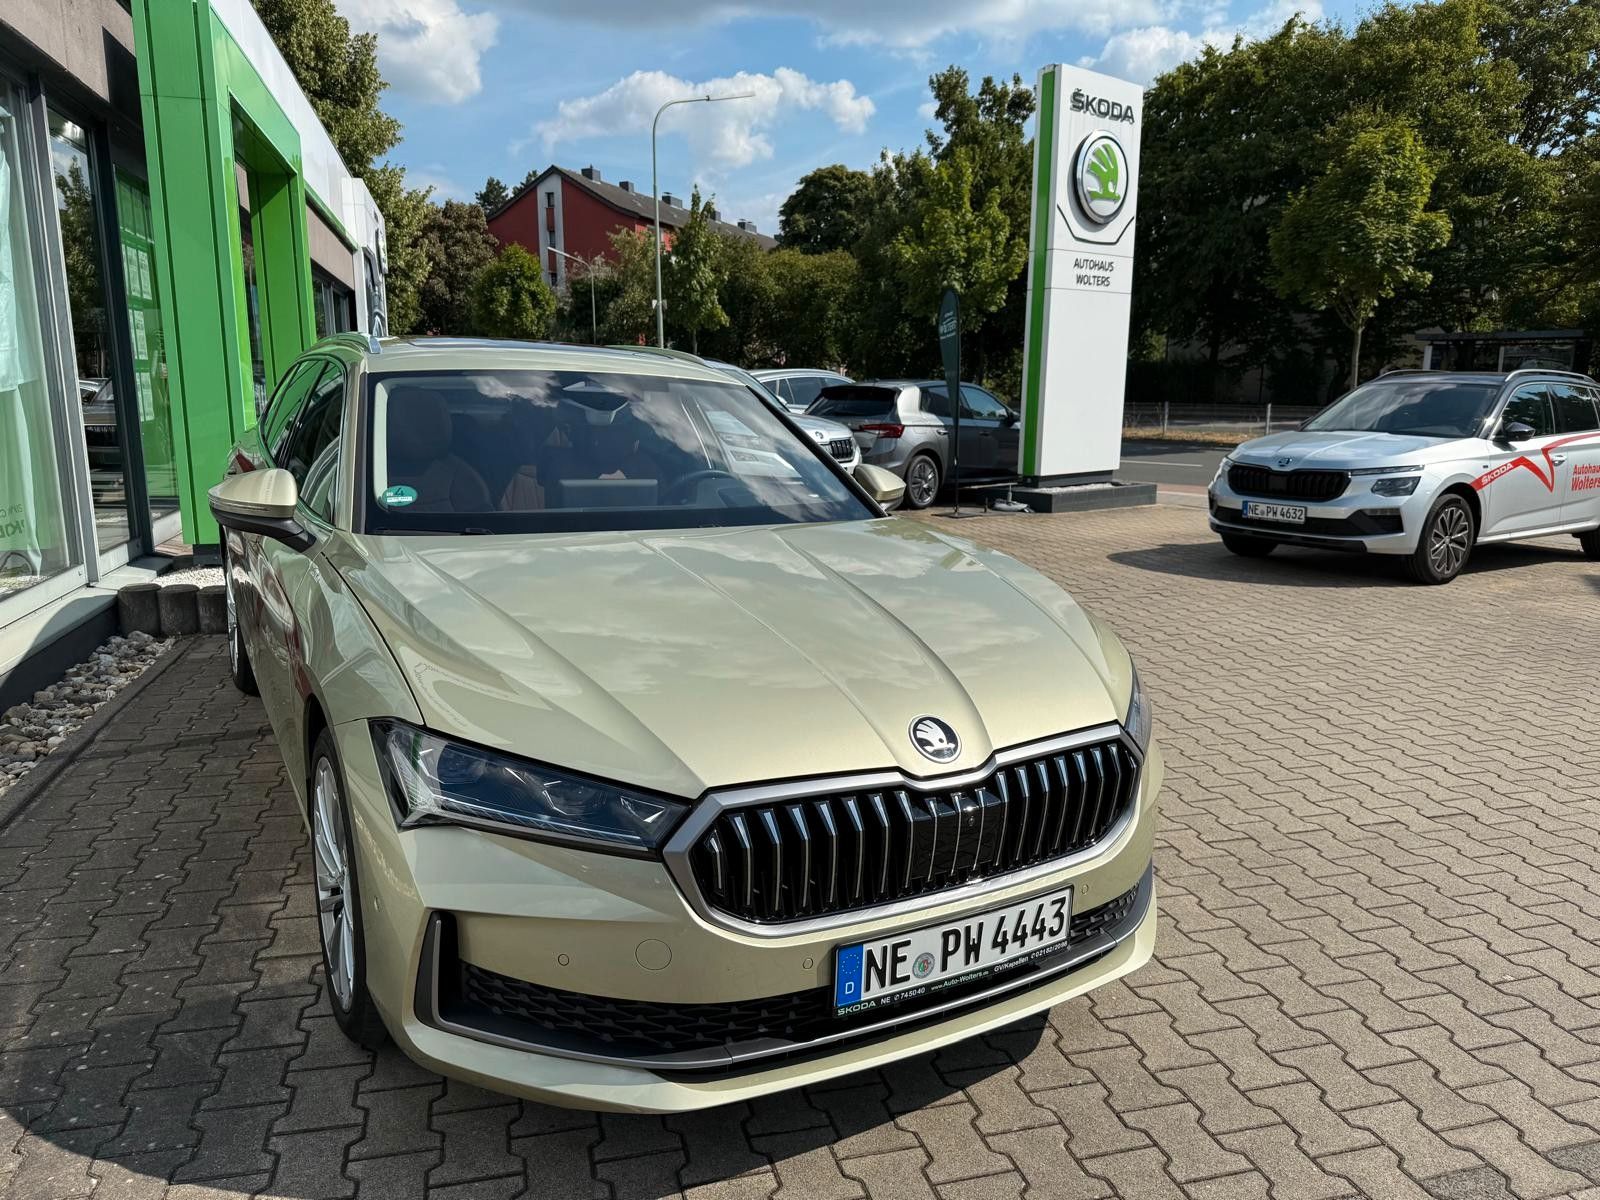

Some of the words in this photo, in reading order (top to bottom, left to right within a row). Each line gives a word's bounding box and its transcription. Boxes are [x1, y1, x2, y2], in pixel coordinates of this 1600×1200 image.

[1071, 88, 1135, 126] ŠKODA
[1073, 257, 1115, 272] AUTOHAUS
[1075, 273, 1111, 287] WOLTERS
[1248, 504, 1260, 516] NE
[1266, 506, 1277, 518] PW
[1279, 507, 1303, 520] 4632
[863, 939, 911, 993] NE
[940, 921, 984, 972] PW
[991, 896, 1067, 955] 4443
[881, 996, 891, 1006] NE
